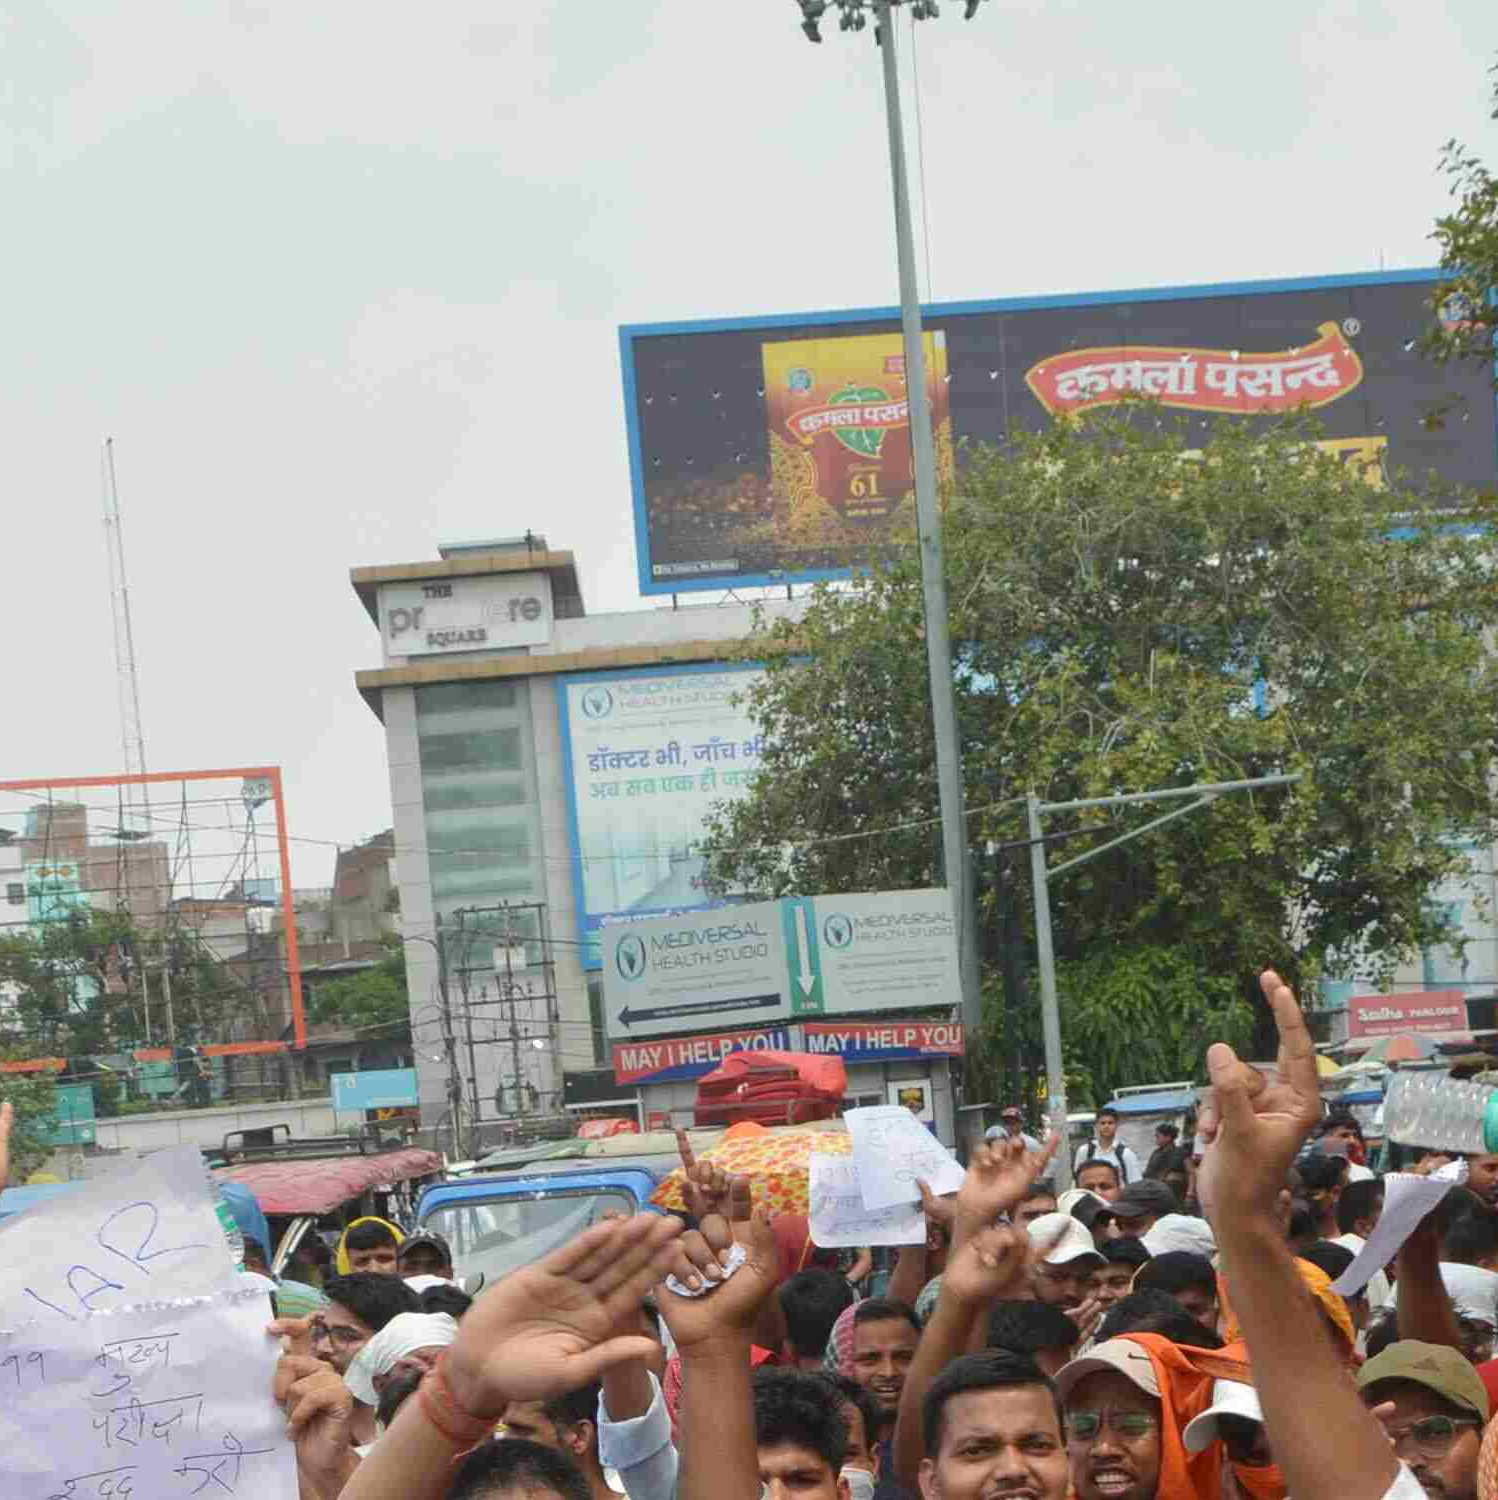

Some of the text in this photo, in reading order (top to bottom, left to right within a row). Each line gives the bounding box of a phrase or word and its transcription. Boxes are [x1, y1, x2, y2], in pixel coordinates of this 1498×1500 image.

[1054, 352, 1342, 400] कमला पसन्द
[850, 473, 879, 497] 61
[421, 584, 453, 599] THE
[426, 629, 488, 646] SQUARE
[587, 745, 650, 773] डॉक्टर
[651, 921, 768, 951] MEDIVERSAL
[652, 943, 768, 971] HEALTH STUDIO
[620, 1030, 783, 1071] MAY I HELP YOU
[809, 1025, 961, 1053] MAY I HELP YOU
